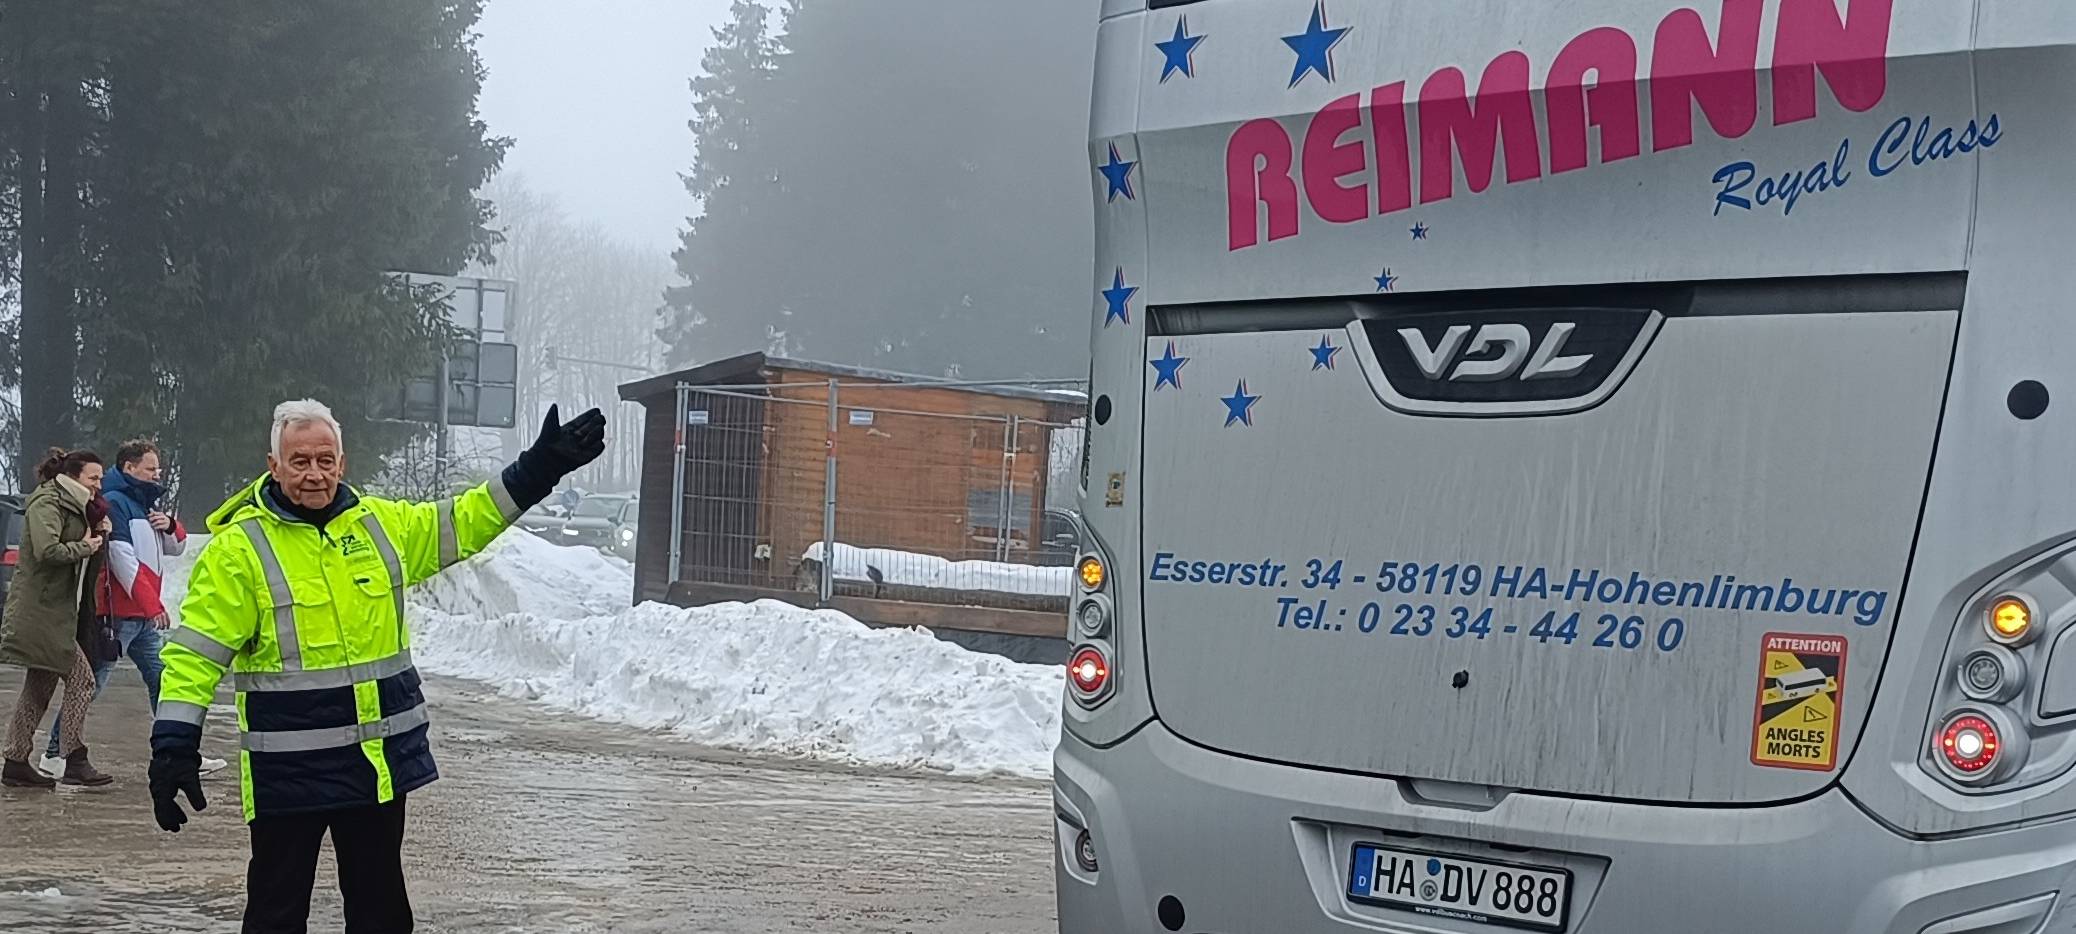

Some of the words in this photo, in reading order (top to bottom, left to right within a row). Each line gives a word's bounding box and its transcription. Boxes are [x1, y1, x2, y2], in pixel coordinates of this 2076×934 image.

[1226, 0, 1892, 251] REIMANN
[1712, 138, 1852, 217] Royal
[1868, 114, 2003, 177] Class
[1397, 322, 1594, 382] VDL
[1150, 552, 1287, 588] Esserstr.
[1301, 559, 1343, 590] 34
[1353, 575, 1366, 583] -
[1376, 561, 1482, 596] 58119
[1489, 565, 1888, 627] HA-Hohenlimburg
[1276, 597, 1346, 632] Tel.:
[1358, 602, 1380, 633] 0
[1390, 604, 1435, 637] 23
[1445, 606, 1493, 640] 34
[1504, 624, 1517, 633] -
[1529, 610, 1580, 645] 44
[1592, 614, 1644, 649] 26
[1657, 618, 1684, 652] 0
[1767, 637, 1841, 653] ATTENTION
[1765, 727, 1825, 744] ANGLES
[1767, 742, 1821, 758] MORTS
[1358, 875, 1367, 887] D
[1373, 855, 1415, 897] HA
[1440, 864, 1487, 906] DV
[1492, 871, 1558, 917] 888
